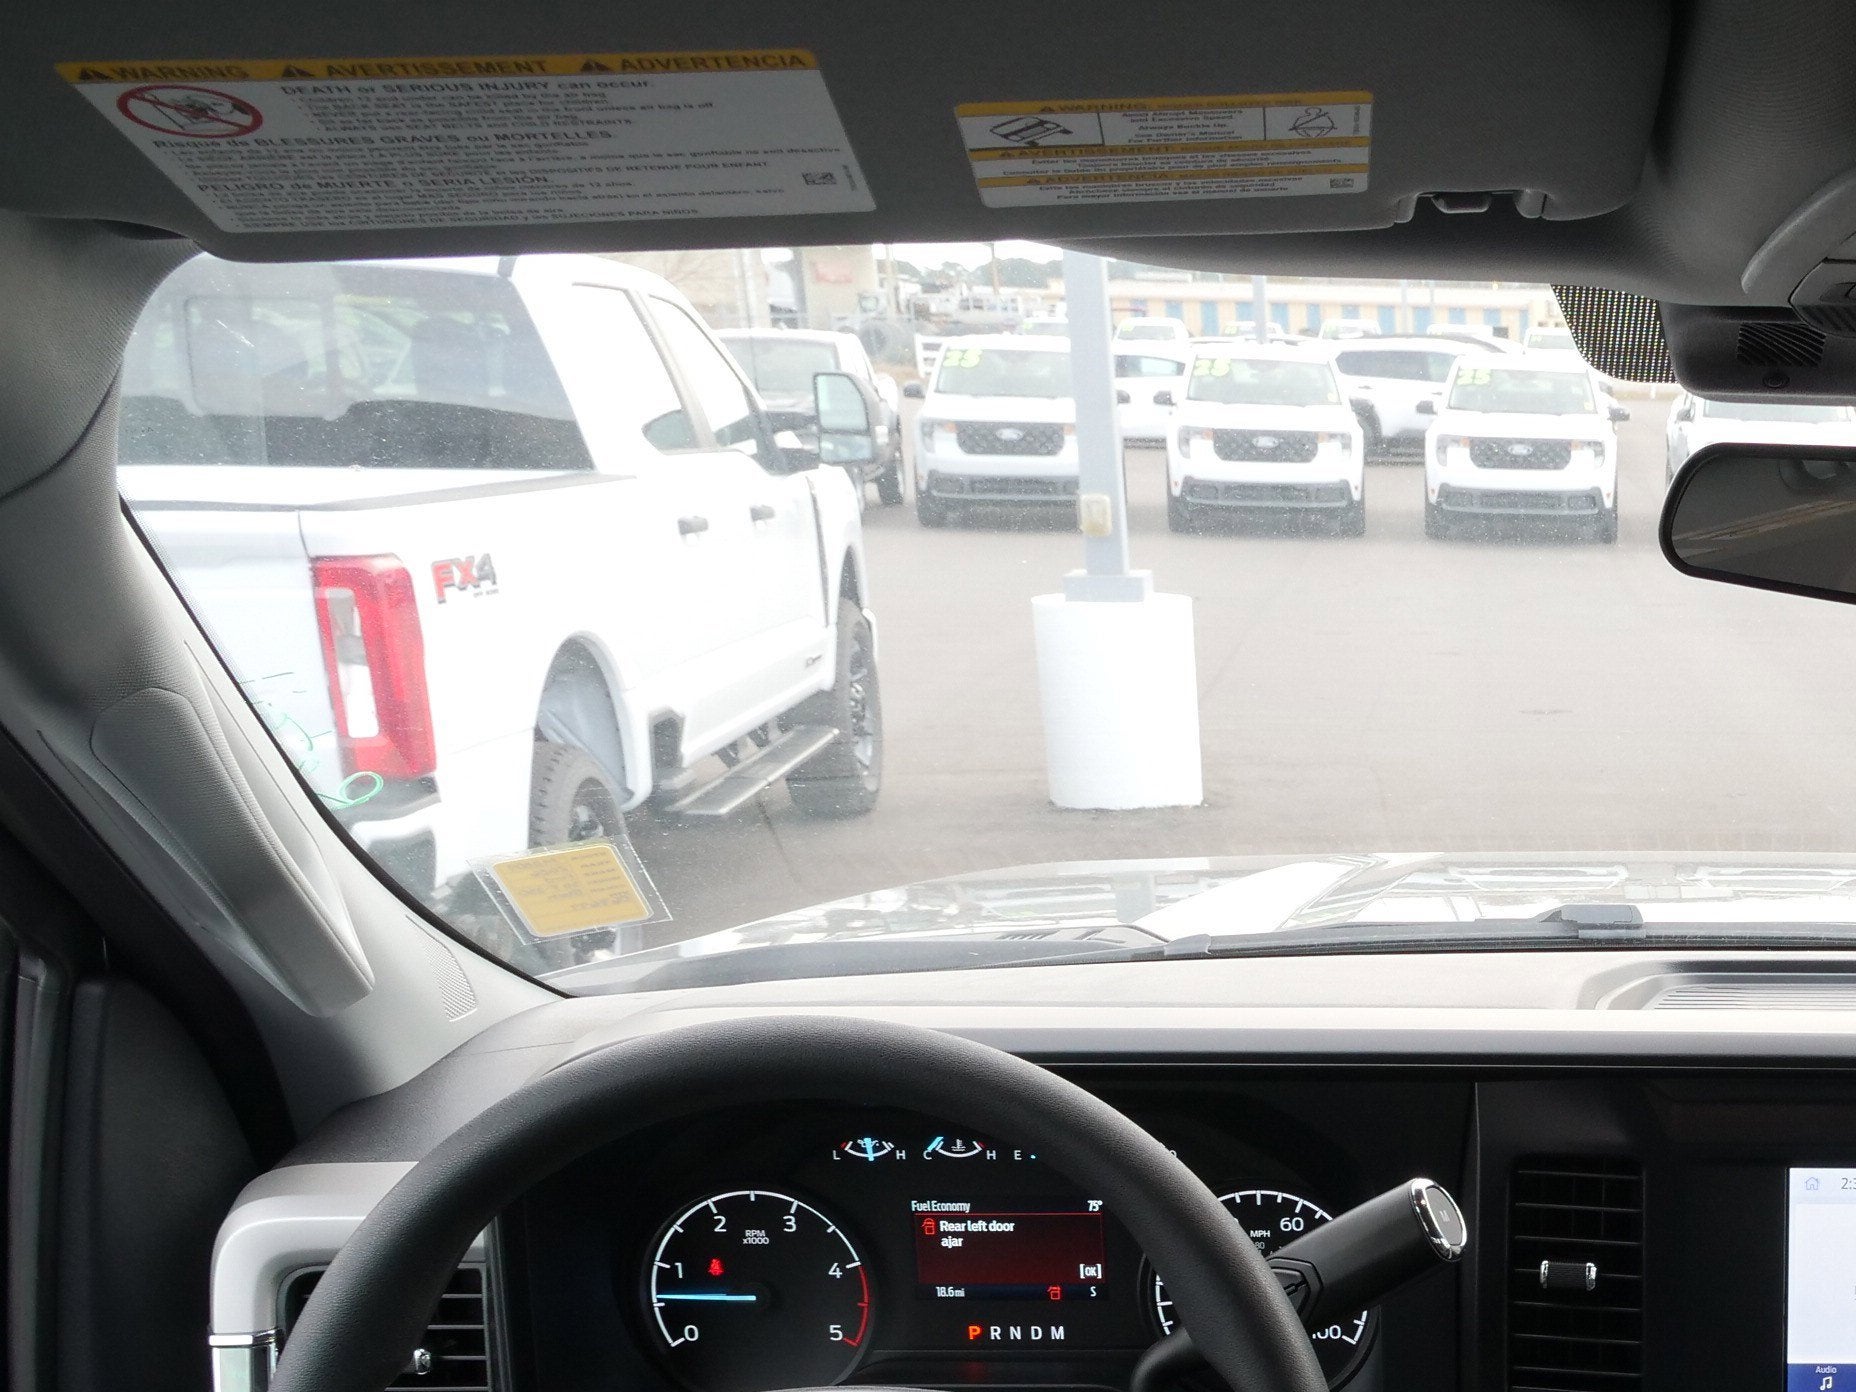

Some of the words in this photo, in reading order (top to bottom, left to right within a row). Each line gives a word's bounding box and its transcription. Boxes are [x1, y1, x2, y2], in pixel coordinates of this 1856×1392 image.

[326, 59, 548, 78] AVERTISSEMENT
[620, 52, 807, 72] ADVERTENCIA
[114, 65, 249, 80] WARNING
[281, 84, 349, 95] DEATH
[383, 81, 474, 93] SERIOUS
[478, 80, 550, 91] INJURY
[430, 552, 498, 604] FX4
[833, 1150, 841, 1160] L
[896, 1150, 906, 1160] H
[923, 1150, 932, 1160] C
[986, 1150, 996, 1160] H
[1014, 1150, 1022, 1160] E
[910, 1200, 931, 1212] Fuel
[931, 1201, 971, 1213] Economy
[713, 1216, 727, 1232] 2
[783, 1216, 797, 1232] 3
[939, 1221, 966, 1232] Rear
[967, 1220, 987, 1232] left
[988, 1220, 1015, 1232] door
[1280, 1218, 1304, 1231] 60
[1250, 1230, 1270, 1238] MPH
[742, 1237, 769, 1245] x1000
[940, 1236, 964, 1249] ajar
[674, 1262, 683, 1279] 1
[828, 1262, 843, 1279] 4
[1090, 1286, 1097, 1297] S
[684, 1325, 699, 1341] 0
[829, 1325, 843, 1341] 5
[968, 1326, 981, 1340] P
[990, 1326, 1001, 1340] R
[1010, 1326, 1021, 1340] N
[1031, 1326, 1042, 1340] D
[1051, 1326, 1065, 1340] M
[1816, 1365, 1837, 1374] Audio
